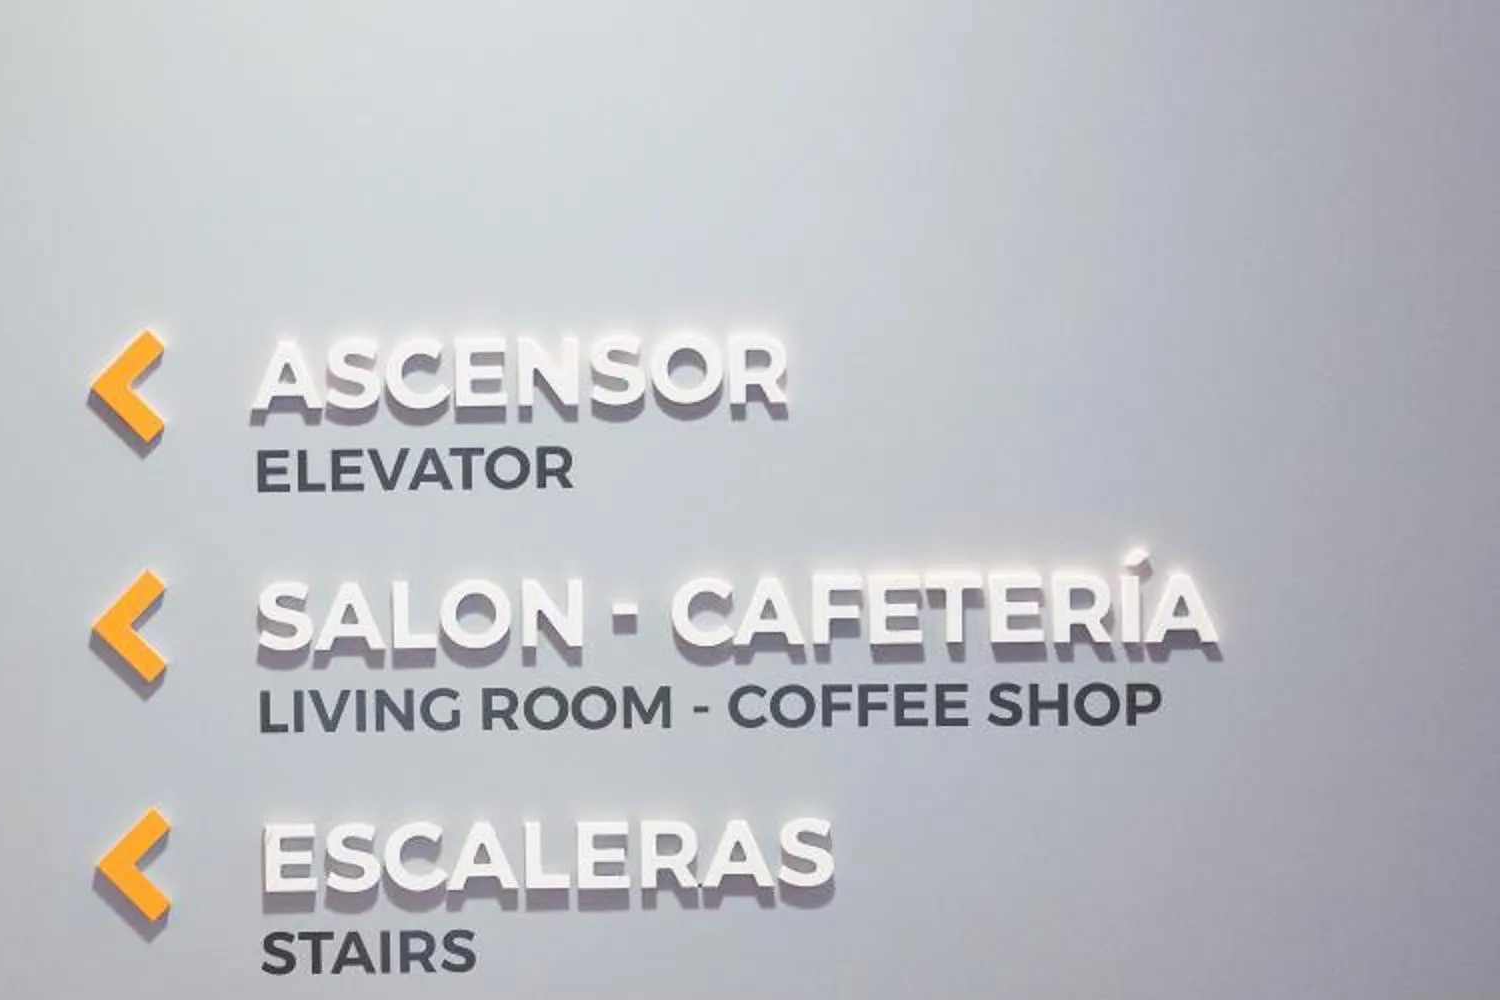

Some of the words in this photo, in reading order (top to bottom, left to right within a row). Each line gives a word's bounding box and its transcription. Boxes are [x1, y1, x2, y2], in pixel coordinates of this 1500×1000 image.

[257, 334, 789, 411] ASCENSOR
[257, 445, 574, 493] ELEVATOR
[258, 577, 583, 651] SALON
[671, 548, 1219, 647] CAFETERÍA
[259, 687, 460, 733] LIVING
[481, 685, 672, 731] ROOM
[728, 683, 969, 729] COFFEE
[987, 682, 1163, 728] SHOP
[263, 818, 835, 894] ESCALERAS
[261, 929, 477, 975] STAIRS
